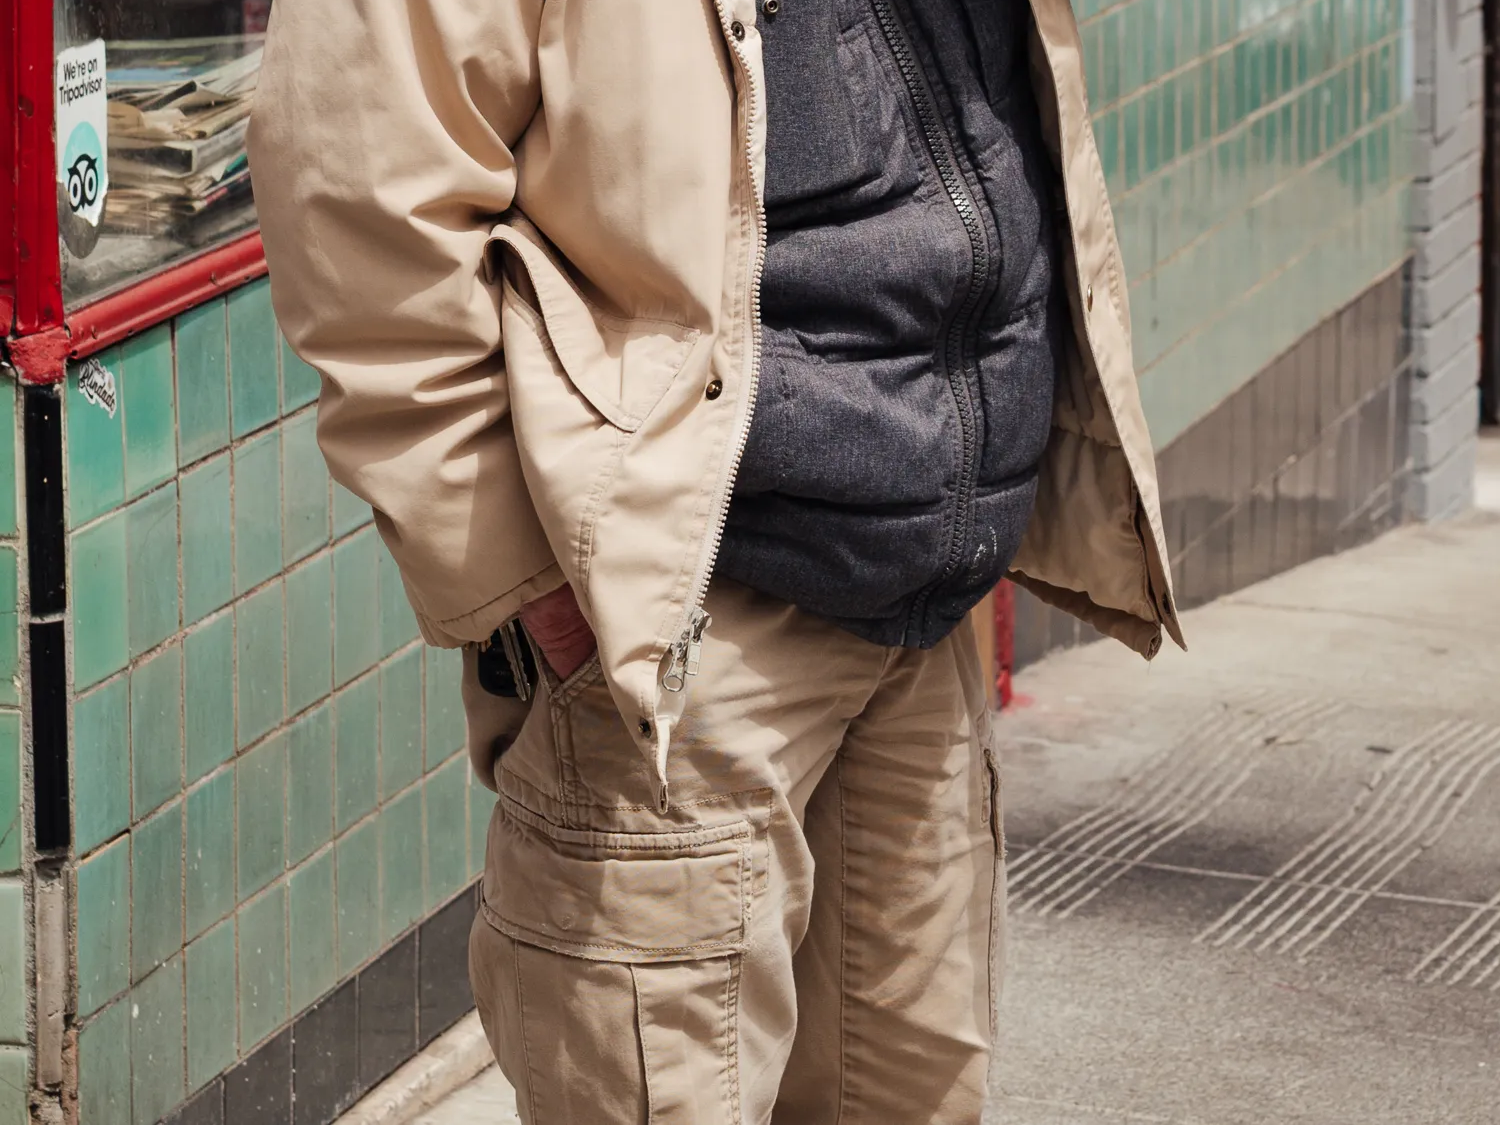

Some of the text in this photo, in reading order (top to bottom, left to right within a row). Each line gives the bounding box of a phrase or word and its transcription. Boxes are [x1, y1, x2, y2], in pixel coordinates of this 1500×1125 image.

[63, 57, 98, 81] We're on
[59, 78, 102, 106] Tripadvisor
